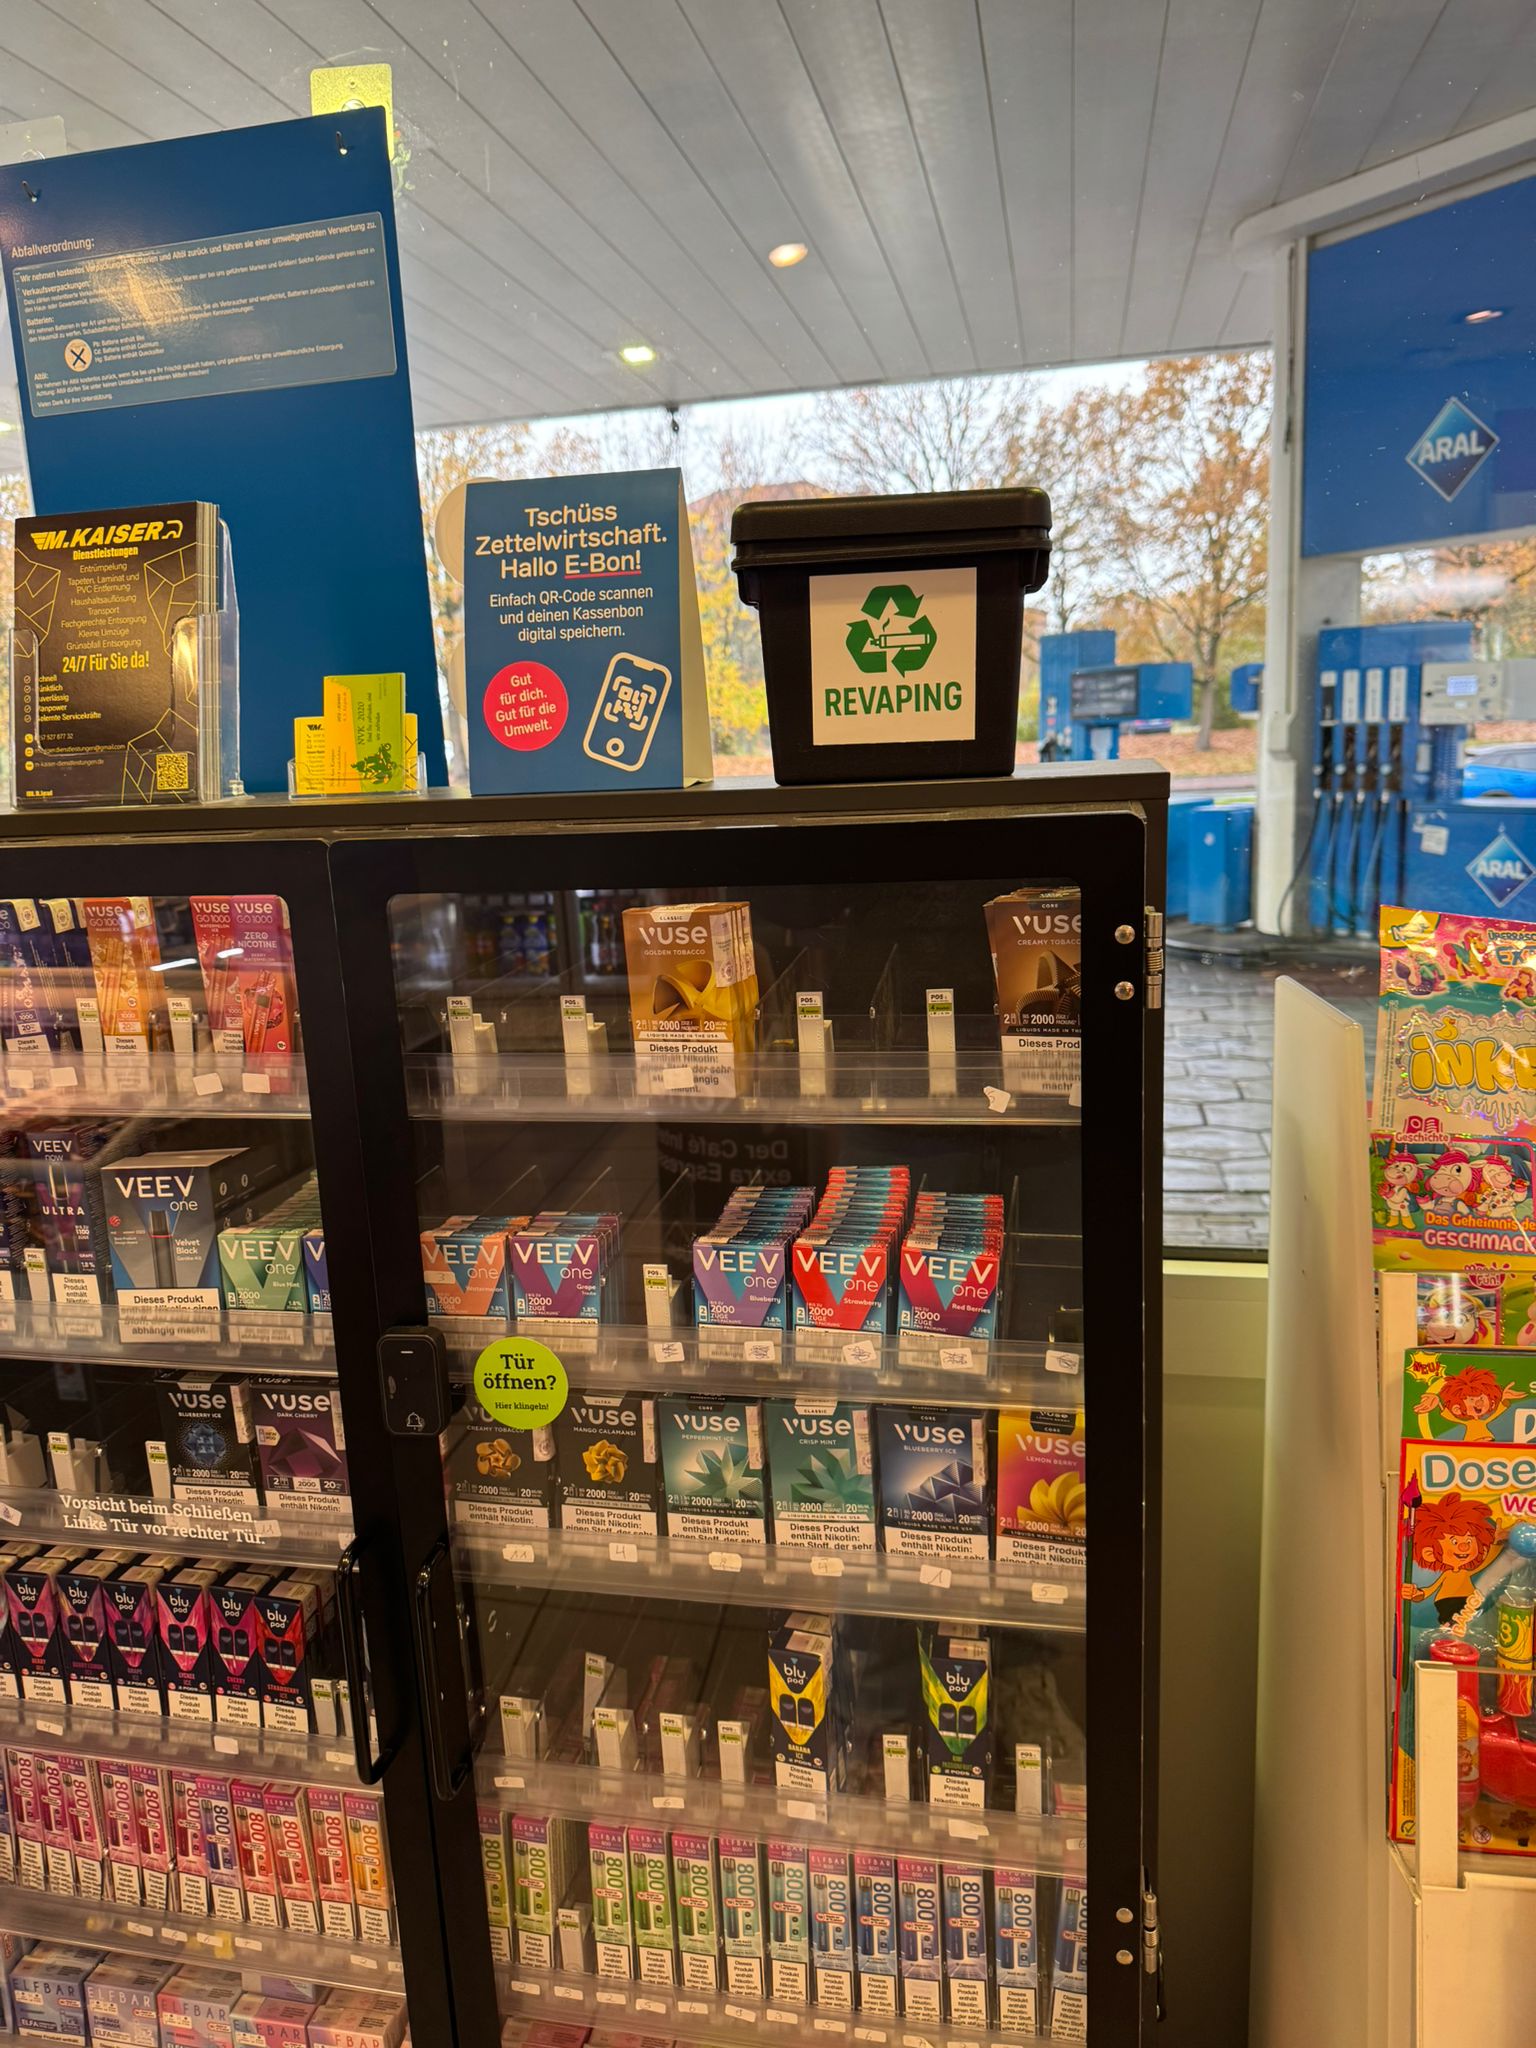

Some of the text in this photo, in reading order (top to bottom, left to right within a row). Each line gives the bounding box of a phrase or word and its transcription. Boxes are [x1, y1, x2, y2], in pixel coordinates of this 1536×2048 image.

[187, 245, 209, 258] zurück
[209, 243, 222, 254] und
[222, 240, 243, 253] führen
[244, 239, 254, 250] sie
[254, 238, 271, 248] einer
[272, 229, 327, 246] umweltgerechten
[327, 222, 365, 237] Verwertung
[366, 221, 377, 231] zu.
[11, 238, 95, 258] Abfallverordnung:
[1417, 429, 1486, 466] ARAL
[524, 503, 618, 527] Tschüss
[42, 520, 162, 550] M.KAISER
[475, 523, 668, 556] Zettelwirtschaft.
[73, 546, 138, 561] Dienstleistungen
[79, 561, 128, 574] Entrümpelung
[500, 550, 642, 579] Hallo E-Bon!
[96, 573, 122, 584] Laminat
[124, 572, 140, 582] und
[76, 582, 131, 594] PVC Entfernung
[489, 586, 653, 608] Einfach QR-Code scannen
[88, 606, 120, 617] Transport
[499, 604, 644, 625] und deinen Kassenbon
[61, 613, 147, 629] Fachgerechte Entsorgung
[518, 623, 626, 644] digital speichern.
[66, 637, 142, 651] Grünabfall Entsorgung
[62, 650, 150, 673] 24/7 Für Sie da!
[510, 672, 532, 687] Gut
[499, 687, 548, 705] für dich.
[824, 681, 962, 717] REVAPING
[495, 702, 557, 722] Gut für die
[504, 718, 553, 738] Umwelt.
[1475, 860, 1528, 880] ARAL
[243, 931, 269, 941] ZERO
[237, 940, 278, 949] NICOTINE
[659, 1020, 681, 1031] 2000
[703, 1020, 715, 1031] 20
[1030, 1013, 1055, 1025] 2000
[649, 1044, 718, 1053] Dieses Produkt
[1395, 1131, 1450, 1144] Geschichte
[115, 1175, 195, 1199] VEEV
[42, 1206, 85, 1217] ULTRA
[169, 1199, 199, 1212] one
[1425, 1213, 1449, 1225] Das
[1451, 1214, 1518, 1231] Geheimnis
[175, 1239, 201, 1247] Velvet
[221, 1240, 295, 1260] VEEV
[176, 1246, 198, 1255] Black
[422, 1243, 498, 1265] VEEV
[514, 1243, 594, 1265] VEEV
[265, 1262, 296, 1275] one
[697, 1249, 780, 1274] VEEV
[797, 1249, 882, 1278] VEEV
[904, 1253, 994, 1284] VEEV
[467, 1266, 499, 1280] one
[560, 1266, 593, 1280] one
[743, 1274, 778, 1290] one
[844, 1276, 879, 1294] one
[1476, 1275, 1500, 1286] Fun!
[576, 1283, 596, 1293] Grape
[134, 1295, 205, 1304] Dieses Produkt
[749, 1294, 781, 1305] Blueberry
[843, 1297, 882, 1308] Strawberry
[951, 1302, 991, 1315] Red Berries
[500, 1354, 535, 1370] Tür
[1413, 1361, 1440, 1378] NEU!
[483, 1373, 557, 1391] öffnen?
[495, 1401, 549, 1411] Hier klingeln!
[178, 1411, 210, 1419] BLUEBERRY
[598, 1428, 636, 1436] CALAMANSI
[903, 1445, 944, 1454] BLUEBERRY
[1026, 1456, 1078, 1467] LEMON BERRY
[59, 1494, 259, 1524] Vorsicht beim Schließen.
[575, 1508, 641, 1521] Dieses Produkt
[469, 1512, 534, 1525] enthält Nikotin:
[681, 1516, 749, 1528] Dieses Produkt
[63, 1514, 266, 1545] Linke Tür vor rechter Tür.
[791, 1531, 860, 1543] enthält Nikotin:
[901, 1539, 973, 1553] enthält Nikotin:
[17, 1583, 37, 1596] blu
[68, 1585, 88, 1599] blu
[21, 1593, 36, 1602] pod
[72, 1595, 87, 1605] pod
[115, 1591, 135, 1605] blu
[119, 1602, 134, 1611] pod
[1450, 1588, 1485, 1638] BÄNG!
[19, 1757, 33, 1788] 800
[46, 1765, 61, 1797] 800
[73, 1779, 90, 1809] 800
